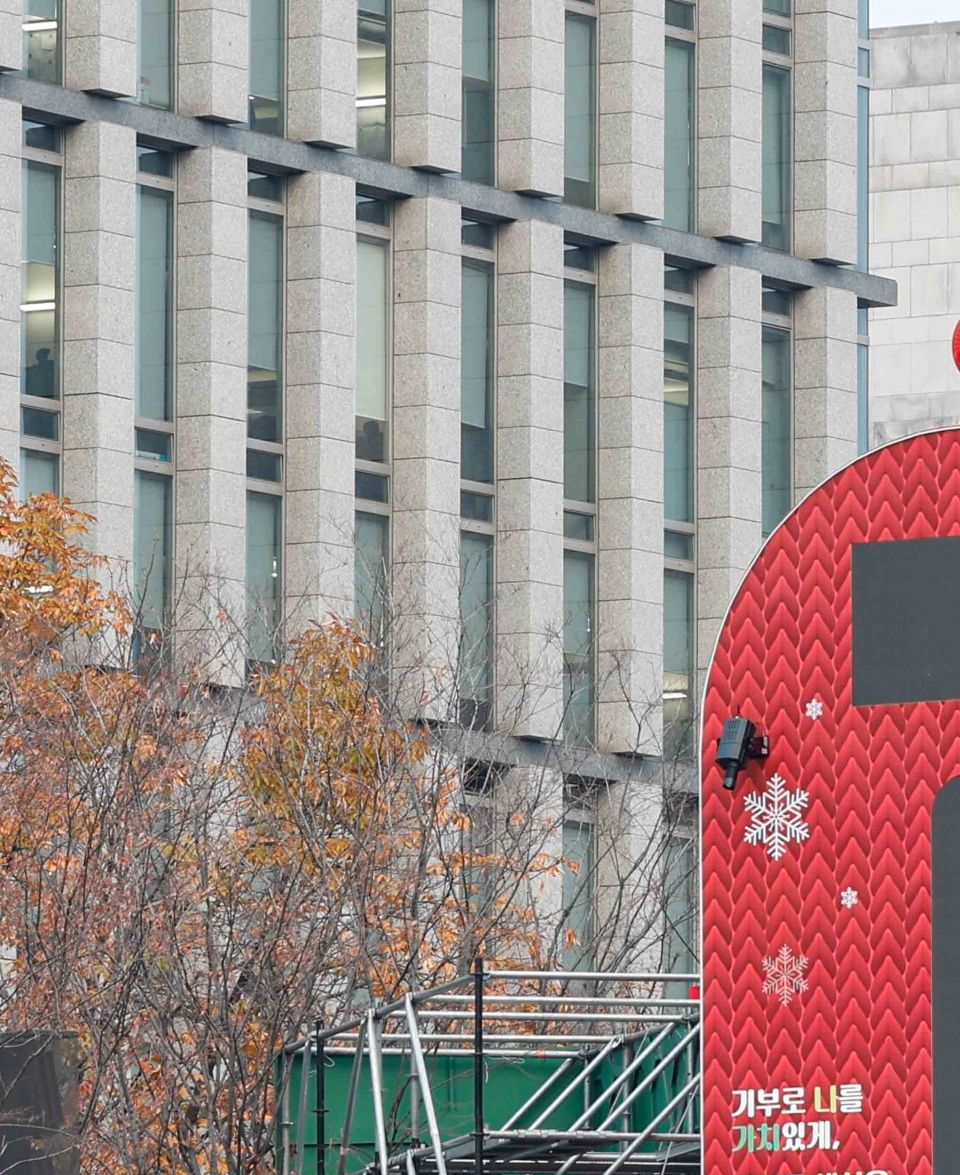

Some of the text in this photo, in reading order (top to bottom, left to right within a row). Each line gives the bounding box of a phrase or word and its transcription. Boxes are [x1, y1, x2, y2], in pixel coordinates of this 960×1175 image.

[732, 1084, 864, 1118] 기부로 나를
[732, 1120, 840, 1152] 가치있게,
